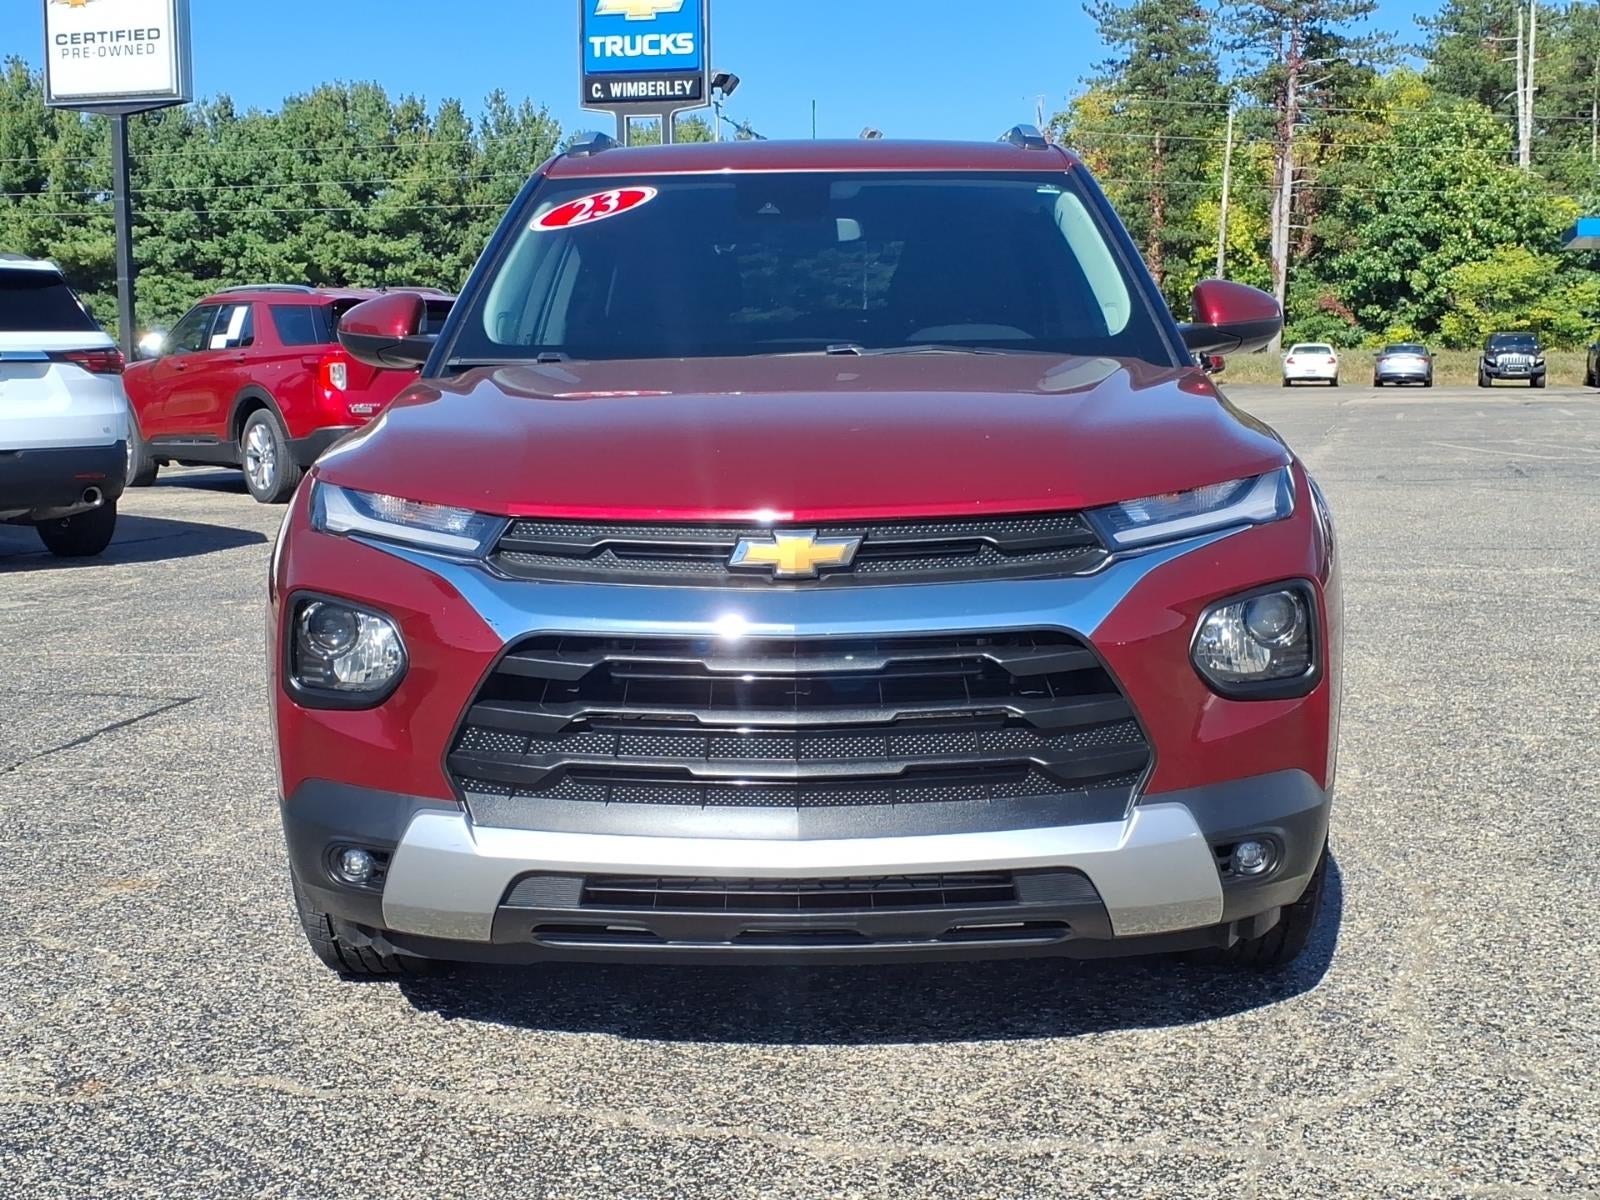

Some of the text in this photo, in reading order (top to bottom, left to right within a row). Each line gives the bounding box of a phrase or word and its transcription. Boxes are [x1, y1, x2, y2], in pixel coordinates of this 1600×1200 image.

[55, 28, 161, 46] CERTIFIED
[589, 33, 695, 57] TRUCKS
[61, 43, 155, 59] PRE-OWNED
[591, 80, 694, 98] C. WIMBERLEY
[567, 191, 621, 225] 23
